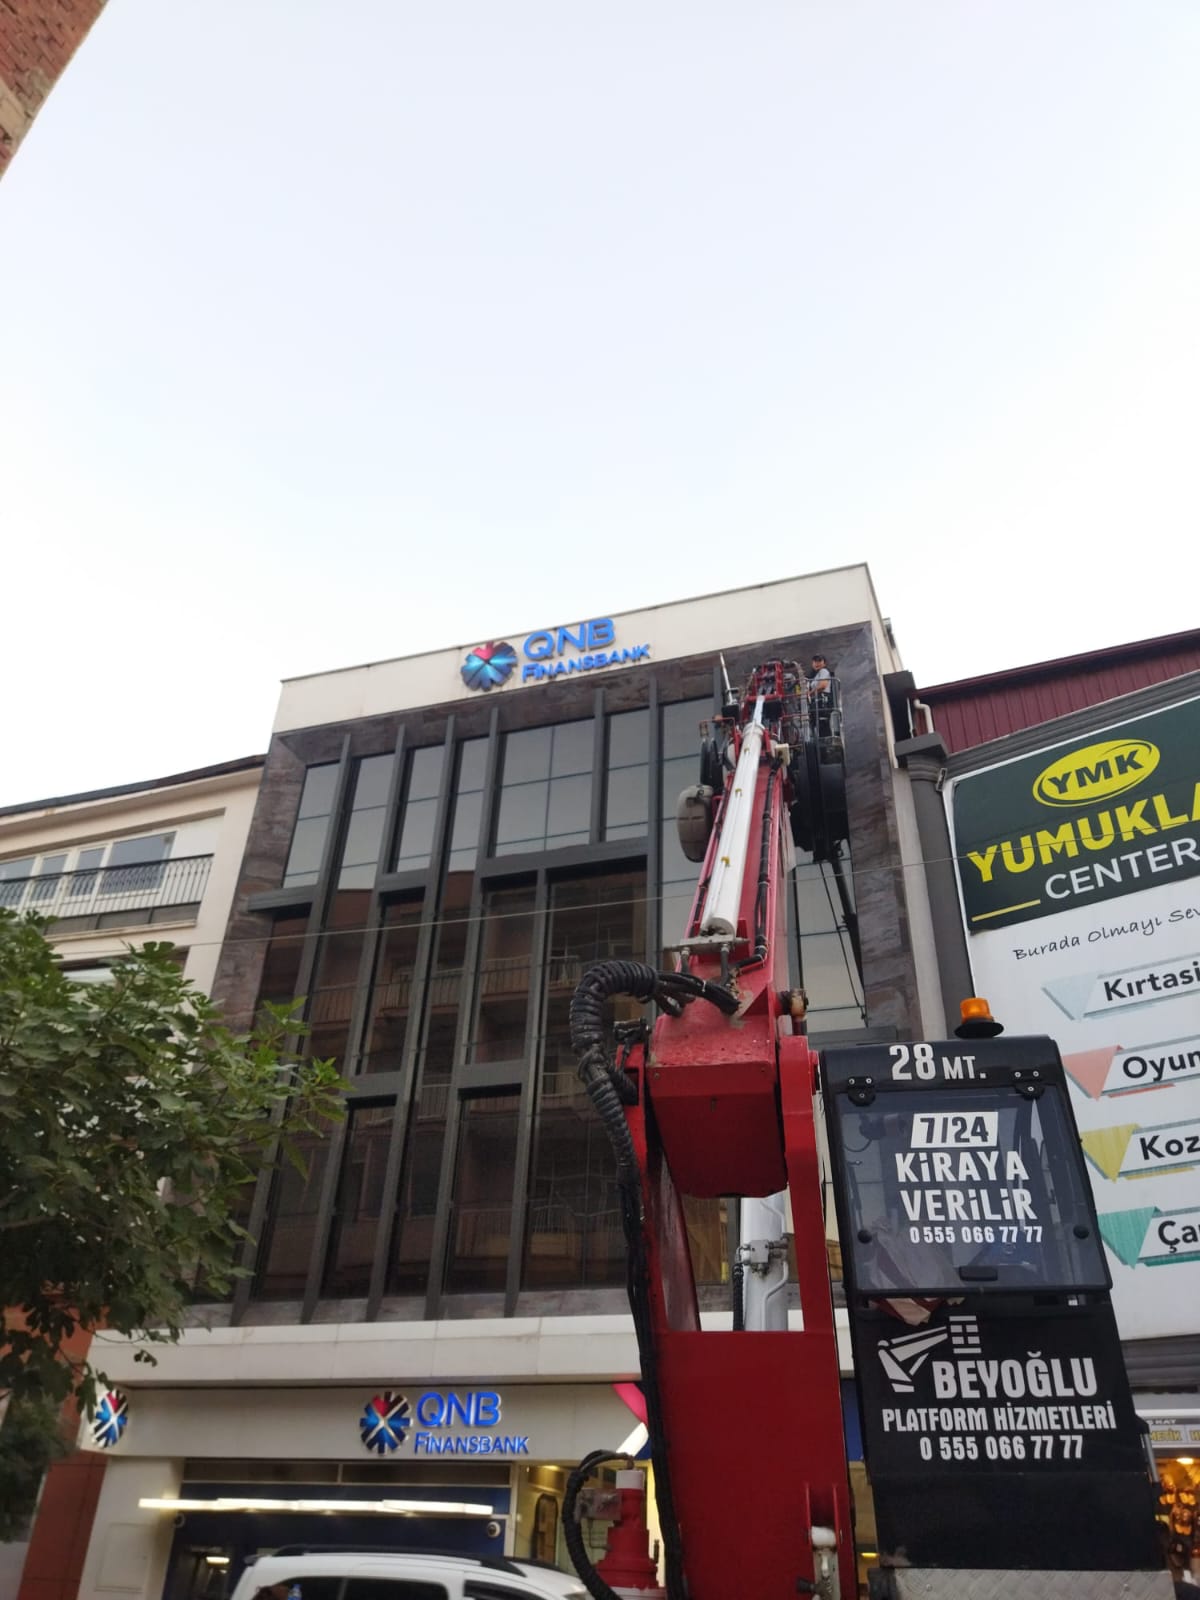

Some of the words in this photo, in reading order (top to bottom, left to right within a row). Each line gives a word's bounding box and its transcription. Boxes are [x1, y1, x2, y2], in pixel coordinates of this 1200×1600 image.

[523, 617, 616, 661] QNB
[1047, 749, 1144, 795] YMK
[966, 782, 1200, 883] YUMUKL
[1045, 837, 1200, 899] CENTER
[1013, 936, 1081, 960] Burada
[1087, 917, 1162, 943] Olmayı
[889, 1043, 937, 1081] 28
[942, 1055, 987, 1080] MT.
[920, 1116, 989, 1144] 7/24
[1139, 1134, 1200, 1161] Koz
[909, 1226, 920, 1243] 0
[924, 1226, 956, 1243] 555
[962, 1226, 995, 1243] 066
[998, 1225, 1018, 1243] 77
[1023, 1225, 1043, 1242] 77
[1157, 1220, 1200, 1254] Ça
[932, 1351, 1098, 1399] BEYOĞLU
[416, 1391, 502, 1428] QNB
[882, 1407, 989, 1432] PLATFORM
[994, 1400, 1117, 1431] HİZMETLERİ
[919, 1437, 933, 1460] 0
[939, 1437, 979, 1460] 555
[985, 1436, 1025, 1460] 066
[1030, 1435, 1054, 1459] 77
[1059, 1435, 1083, 1459] 77
